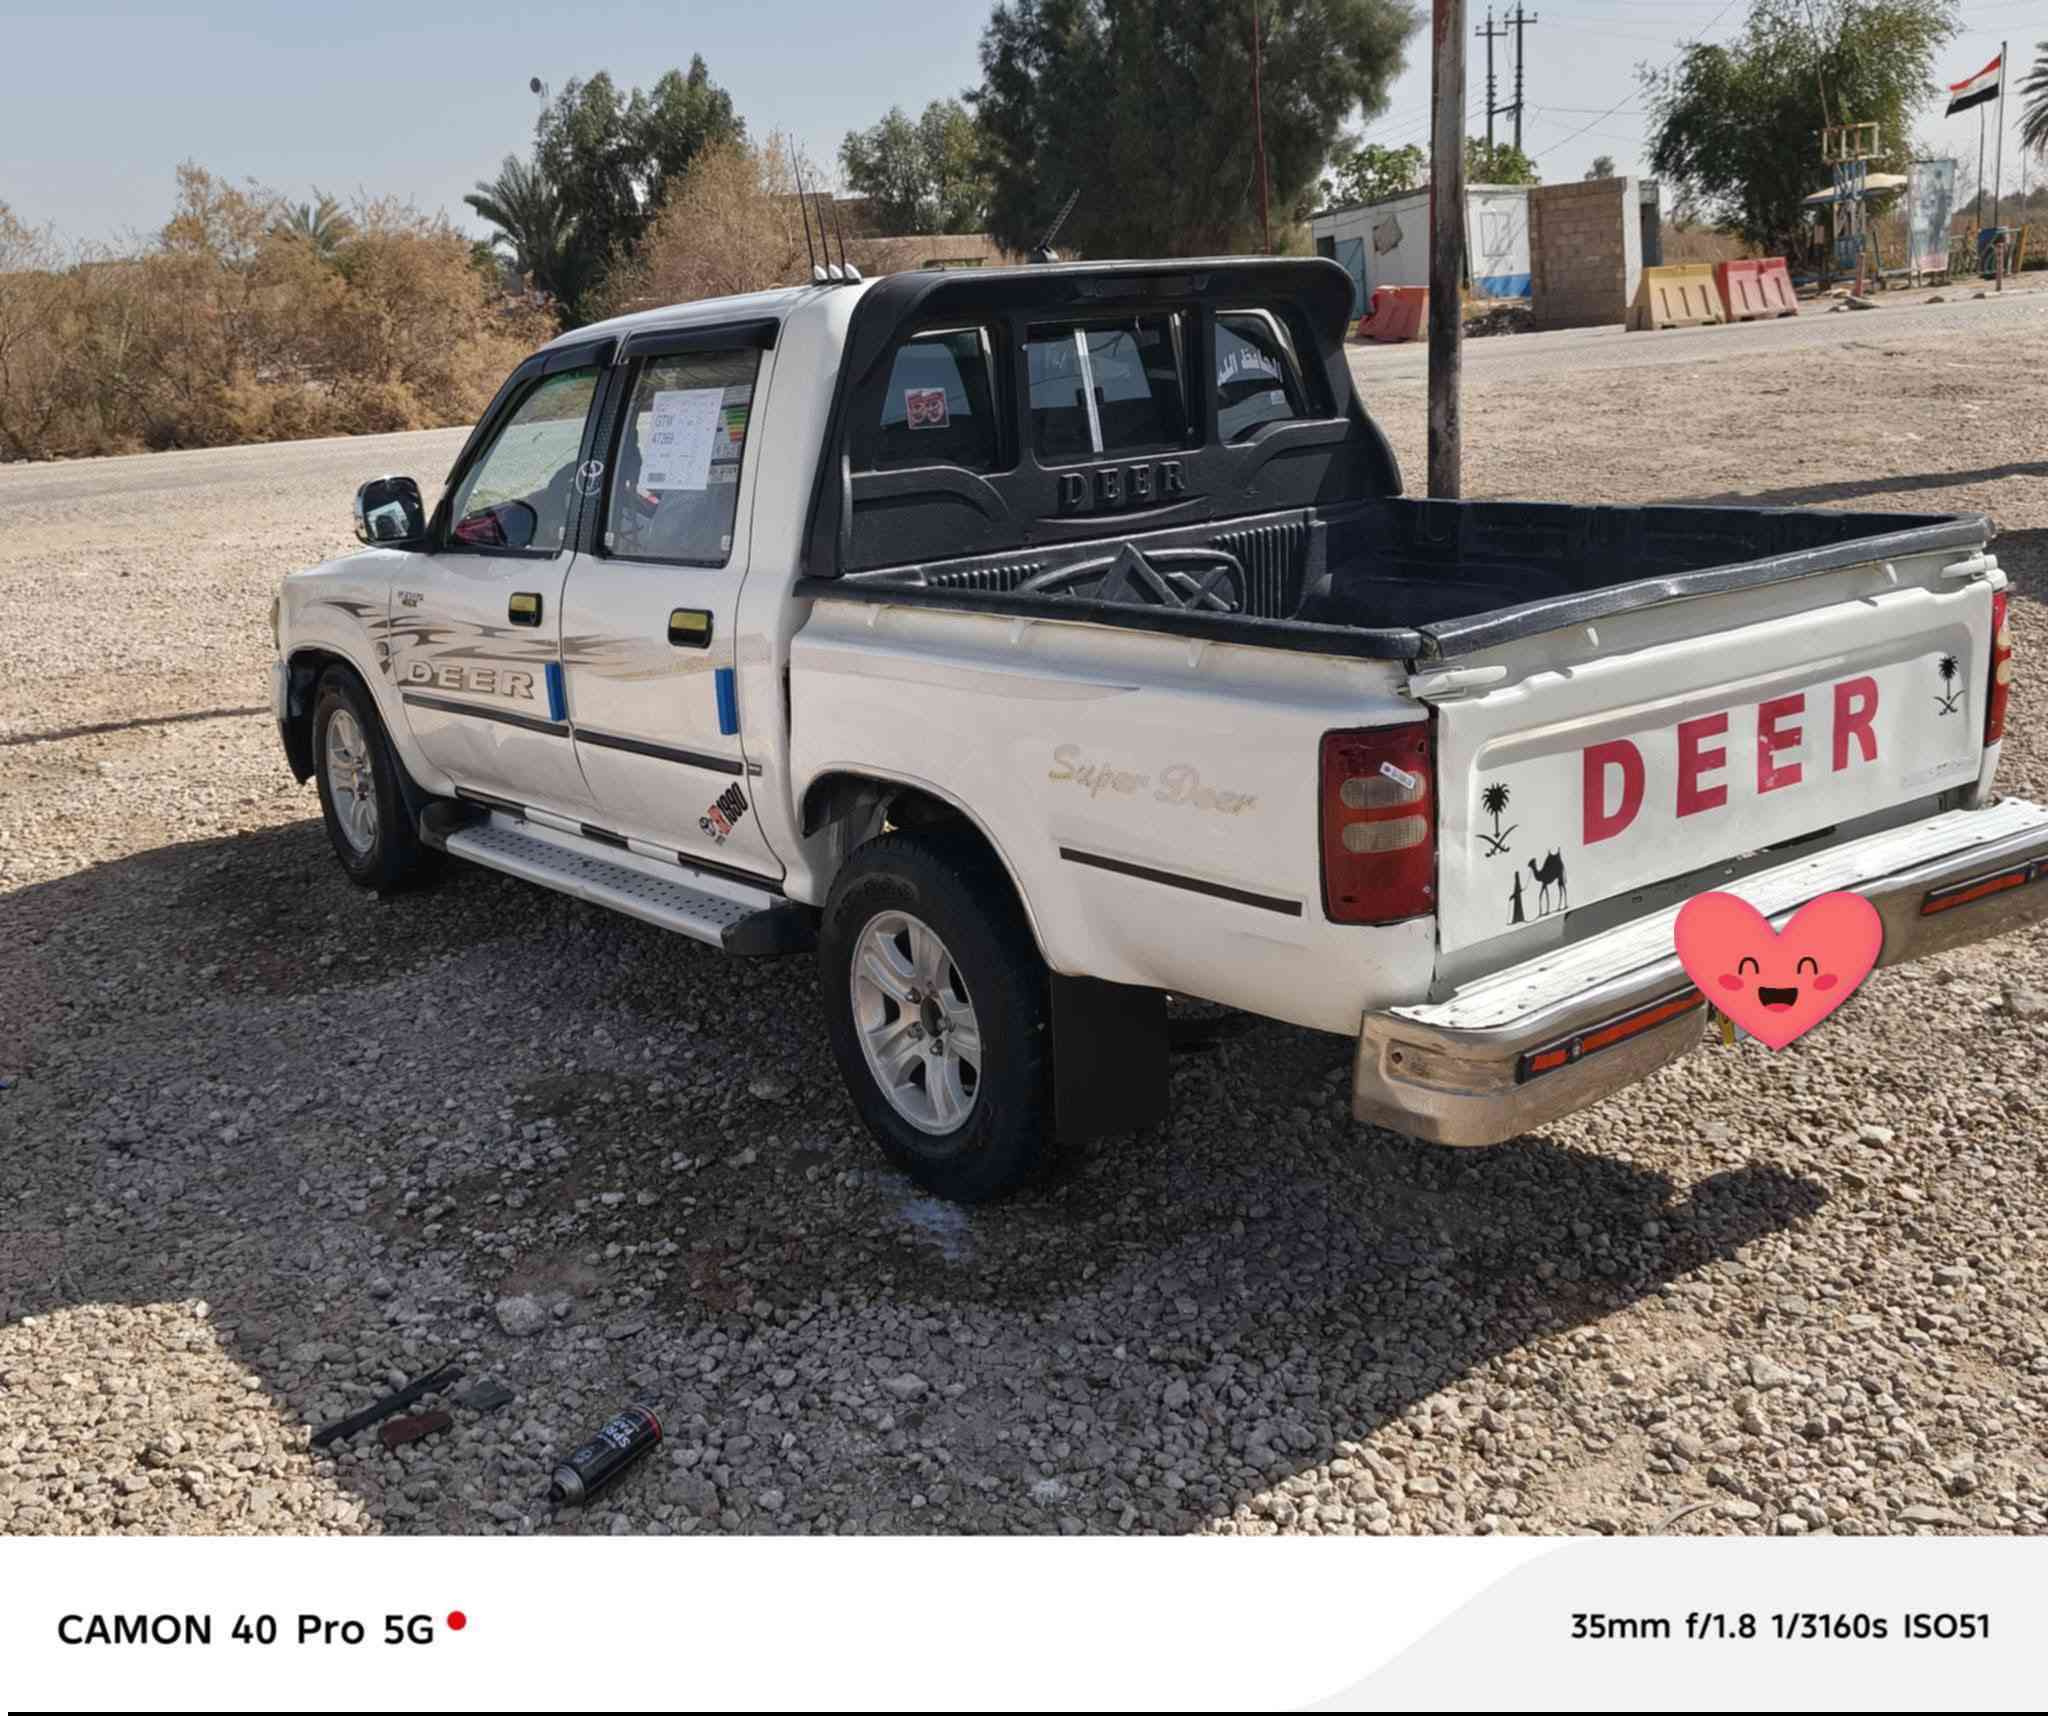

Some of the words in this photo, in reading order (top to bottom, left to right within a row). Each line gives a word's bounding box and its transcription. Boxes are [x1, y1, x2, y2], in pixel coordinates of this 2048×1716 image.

[1058, 460, 1185, 504] DEER
[407, 660, 535, 700] DEER
[1048, 744, 1151, 800] Super
[1153, 764, 1259, 816] Deer
[1583, 676, 1879, 845] DEER
[716, 781, 748, 826] 1990
